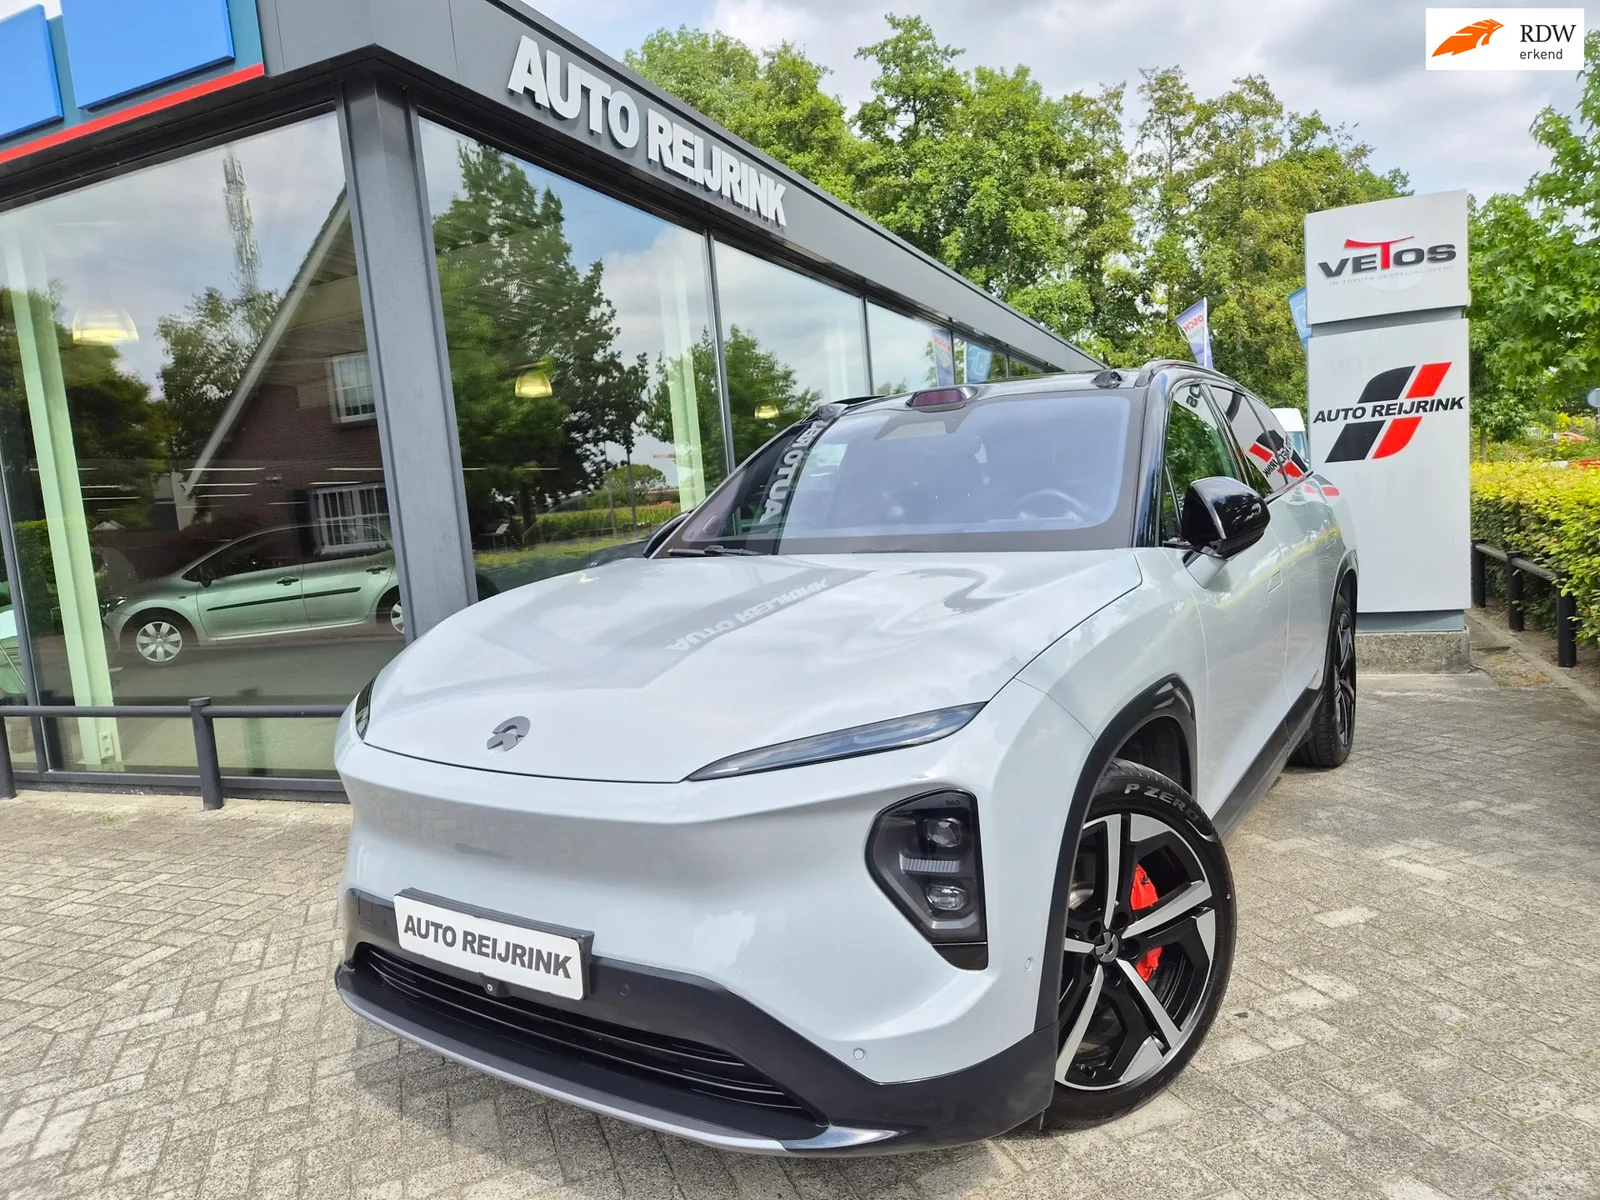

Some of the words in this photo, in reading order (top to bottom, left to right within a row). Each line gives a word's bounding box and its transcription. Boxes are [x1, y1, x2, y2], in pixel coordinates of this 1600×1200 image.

[507, 35, 640, 149] AUTO
[647, 108, 787, 227] REIJRINK
[1318, 236, 1457, 278] VETOS
[1313, 406, 1366, 423] AUTO
[1371, 396, 1465, 417] REIJRINK
[1124, 783, 1140, 794] P
[1143, 786, 1200, 820] ZERO
[404, 914, 457, 948] AUTO
[461, 930, 572, 979] REIJRINK
